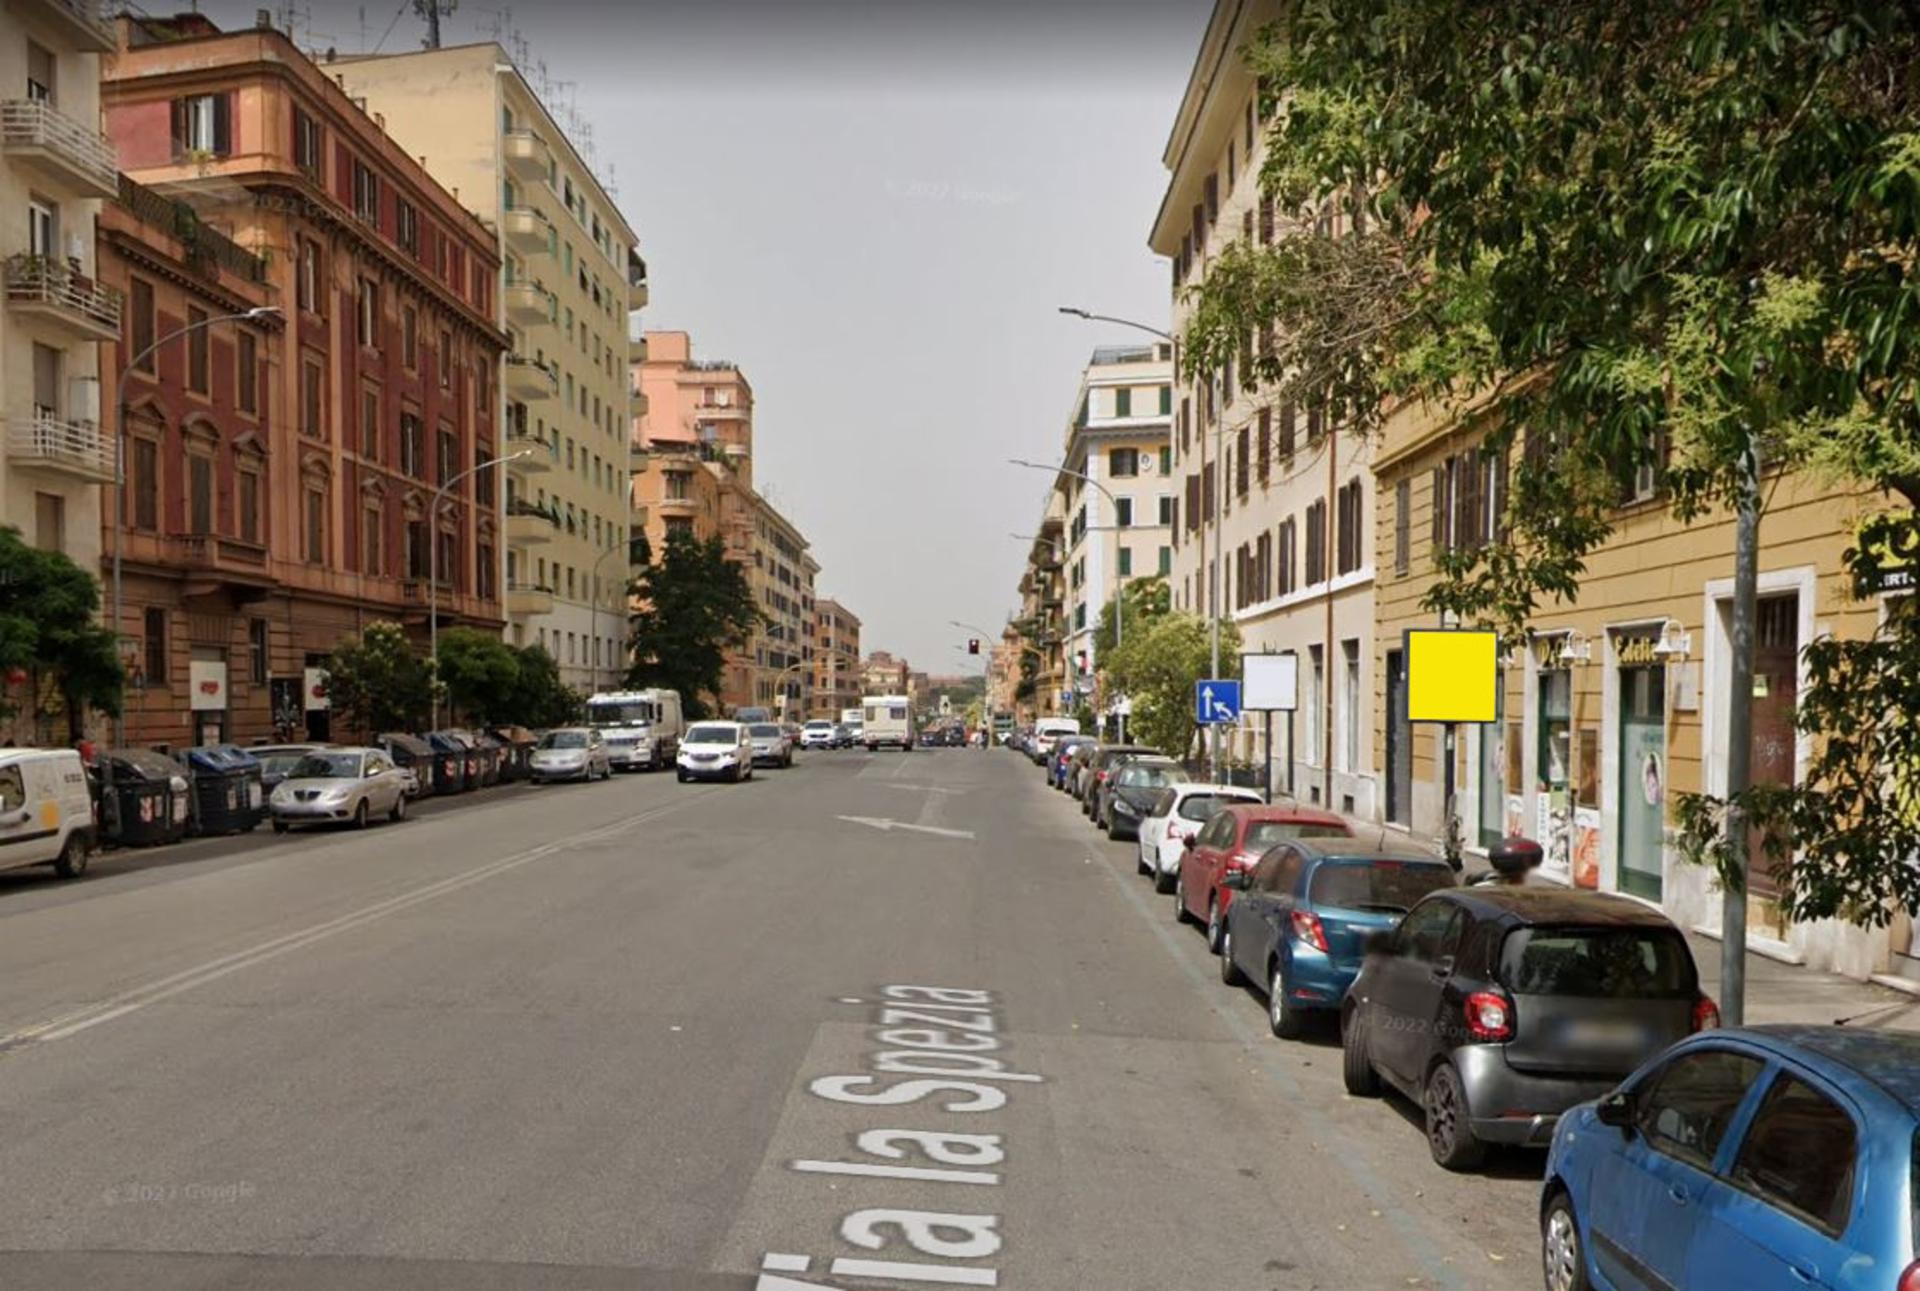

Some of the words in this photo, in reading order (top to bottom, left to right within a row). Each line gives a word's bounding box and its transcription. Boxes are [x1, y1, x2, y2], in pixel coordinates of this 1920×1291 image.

[809, 984, 1044, 1112] Spezia
[793, 1129, 1004, 1184] la
[755, 1208, 1002, 1291] ia
